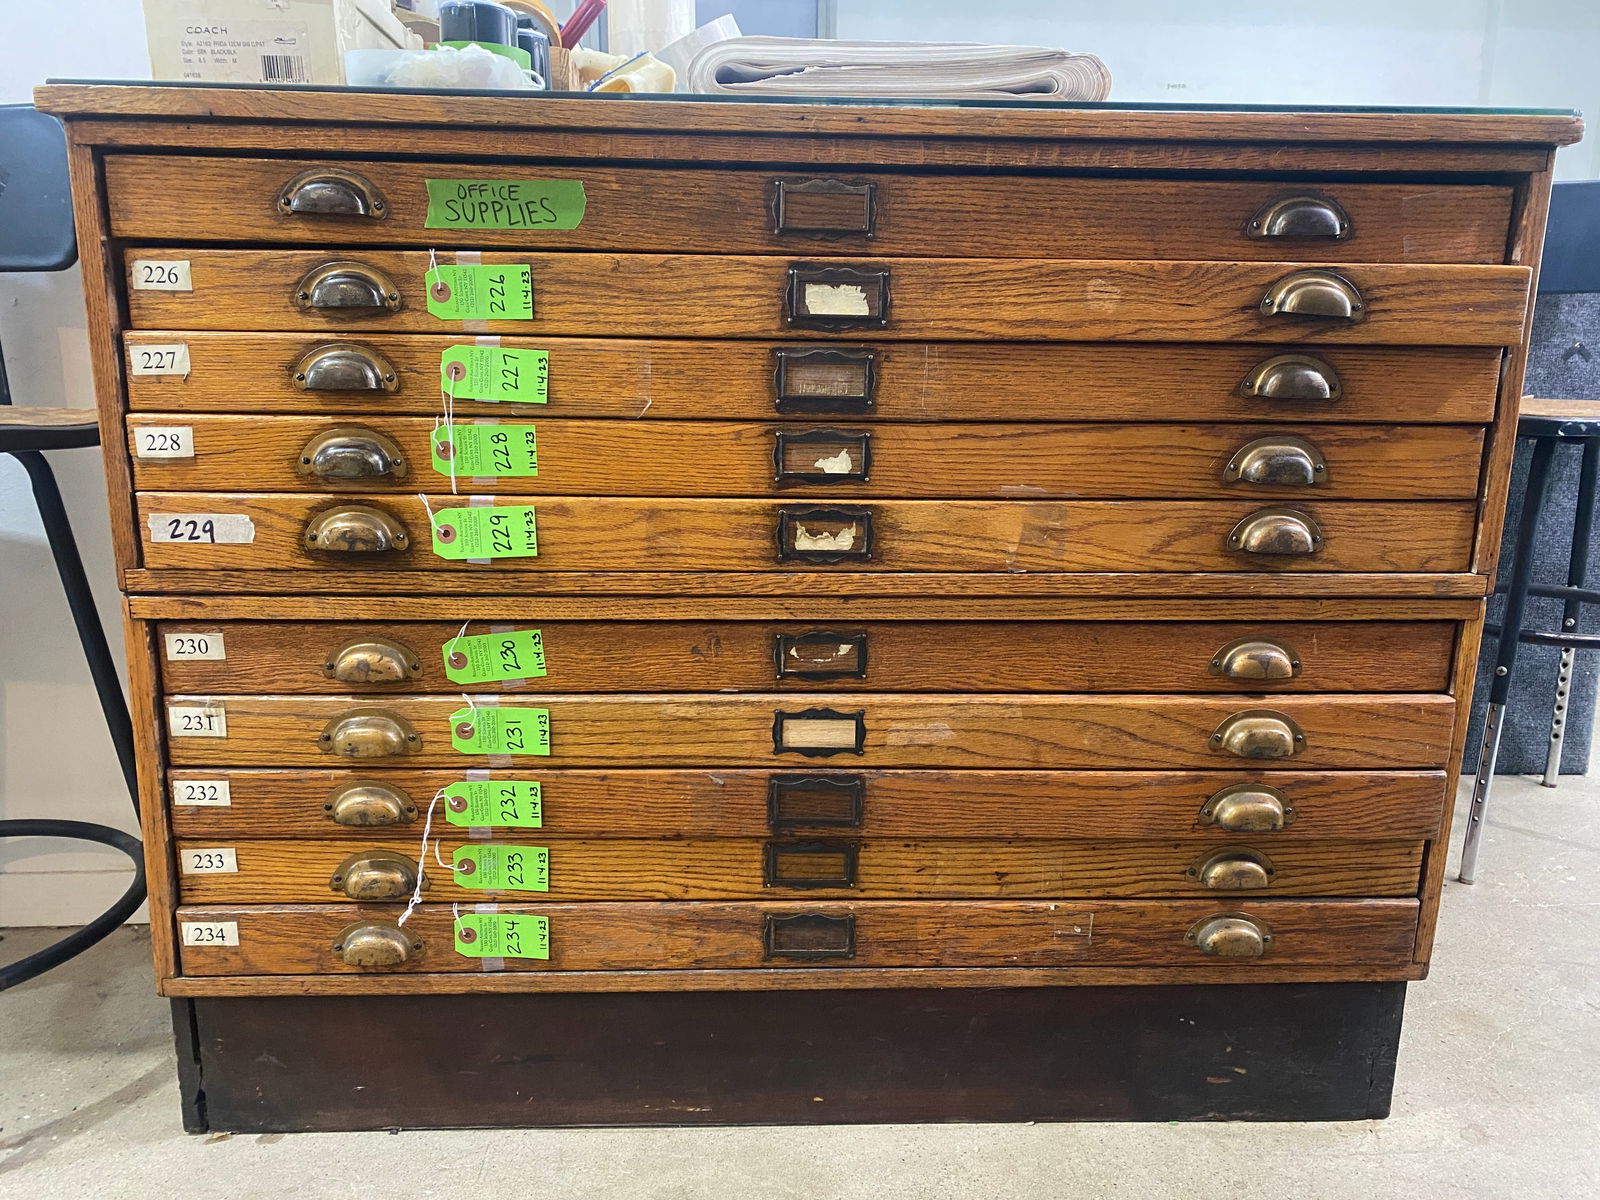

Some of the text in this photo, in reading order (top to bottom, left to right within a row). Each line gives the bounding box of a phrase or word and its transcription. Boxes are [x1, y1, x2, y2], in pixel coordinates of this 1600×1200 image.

[186, 26, 228, 34] COACH
[457, 184, 520, 200] OFFICE
[445, 198, 556, 226] SUPPLIES
[142, 266, 178, 284] 226
[489, 274, 505, 313] 226
[140, 352, 176, 369] 227
[502, 354, 519, 391] 227
[146, 434, 180, 451] 228
[491, 433, 512, 471] 228
[168, 518, 214, 543] 229
[490, 516, 512, 552] 229
[175, 638, 208, 654] 230
[500, 640, 521, 671] 230
[182, 715, 214, 730] 231
[506, 721, 524, 750] 231
[186, 786, 218, 800] 232
[501, 786, 518, 821] 232
[192, 854, 224, 868] 233
[508, 853, 523, 885] 233
[194, 928, 226, 942] 234
[505, 920, 521, 954] 234
